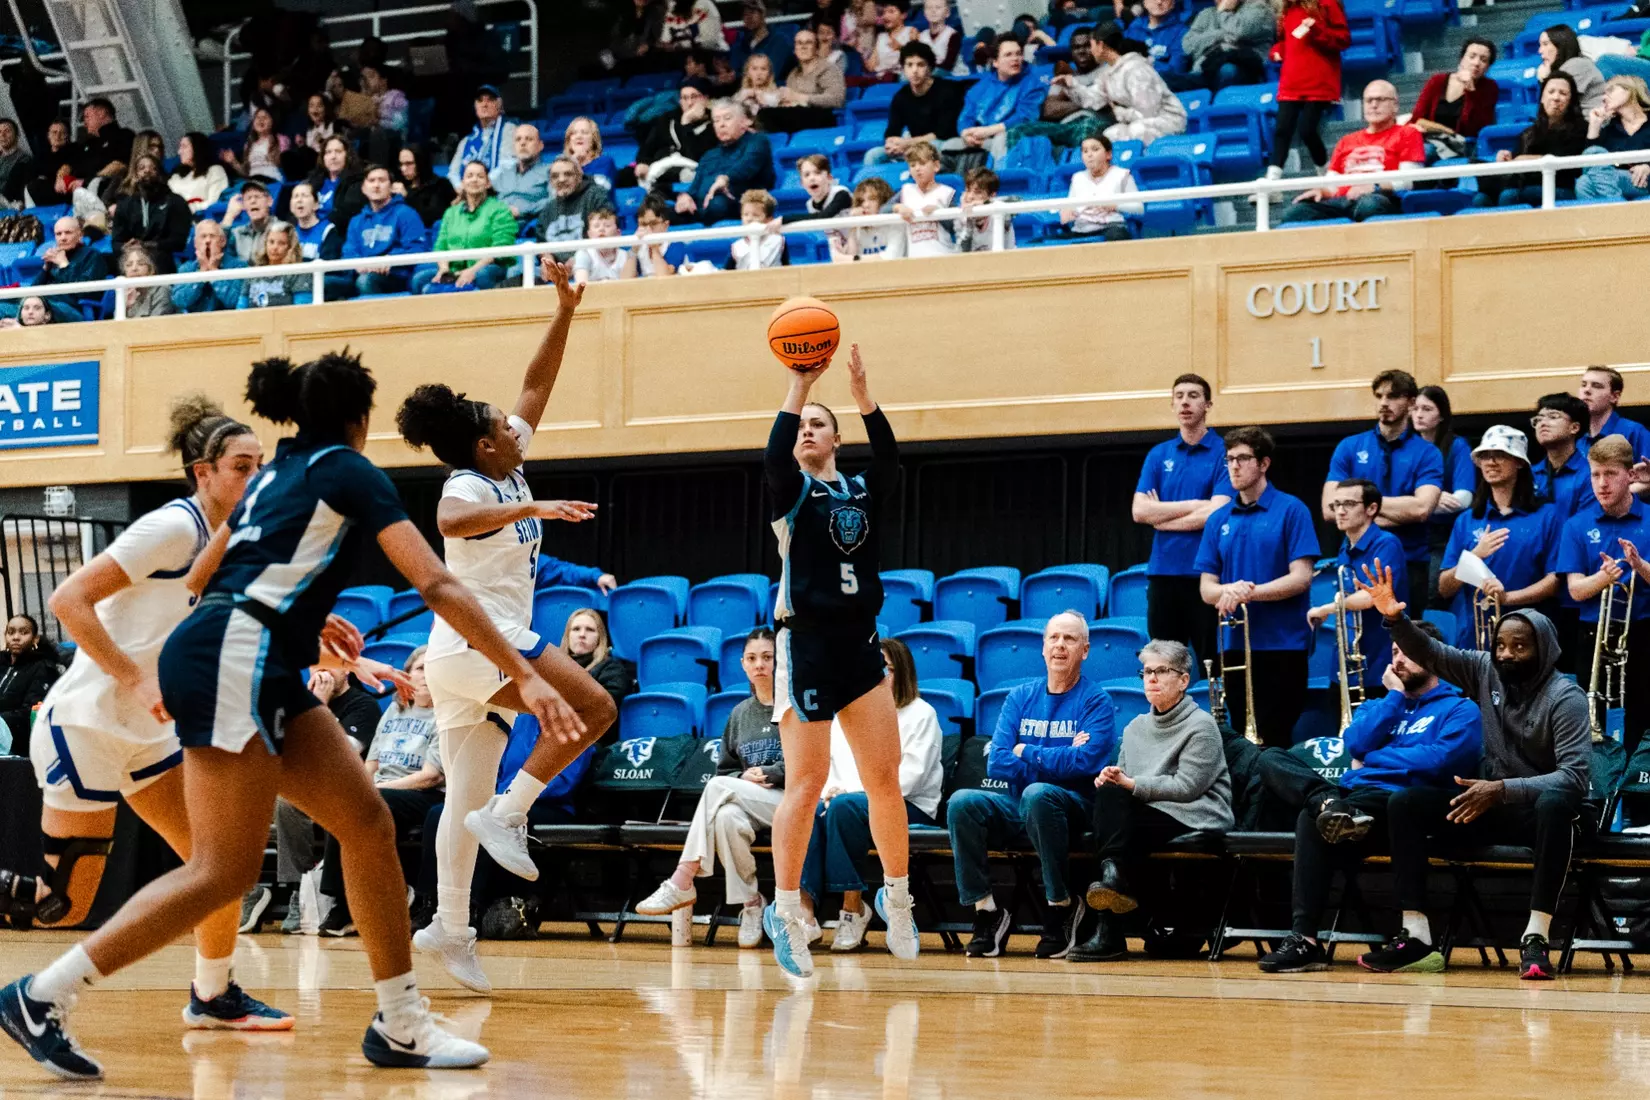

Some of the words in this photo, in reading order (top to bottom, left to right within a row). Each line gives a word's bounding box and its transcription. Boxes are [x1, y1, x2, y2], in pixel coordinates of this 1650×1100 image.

[1246, 276, 1387, 318] COURT
[783, 339, 832, 354] Wilson
[1310, 336, 1325, 369] 1
[840, 562, 859, 594] 5
[804, 689, 818, 711] C
[274, 707, 285, 739] C
[1019, 719, 1049, 738] ETON
[613, 768, 653, 779] SLOAN
[980, 778, 1009, 789] SLOA
